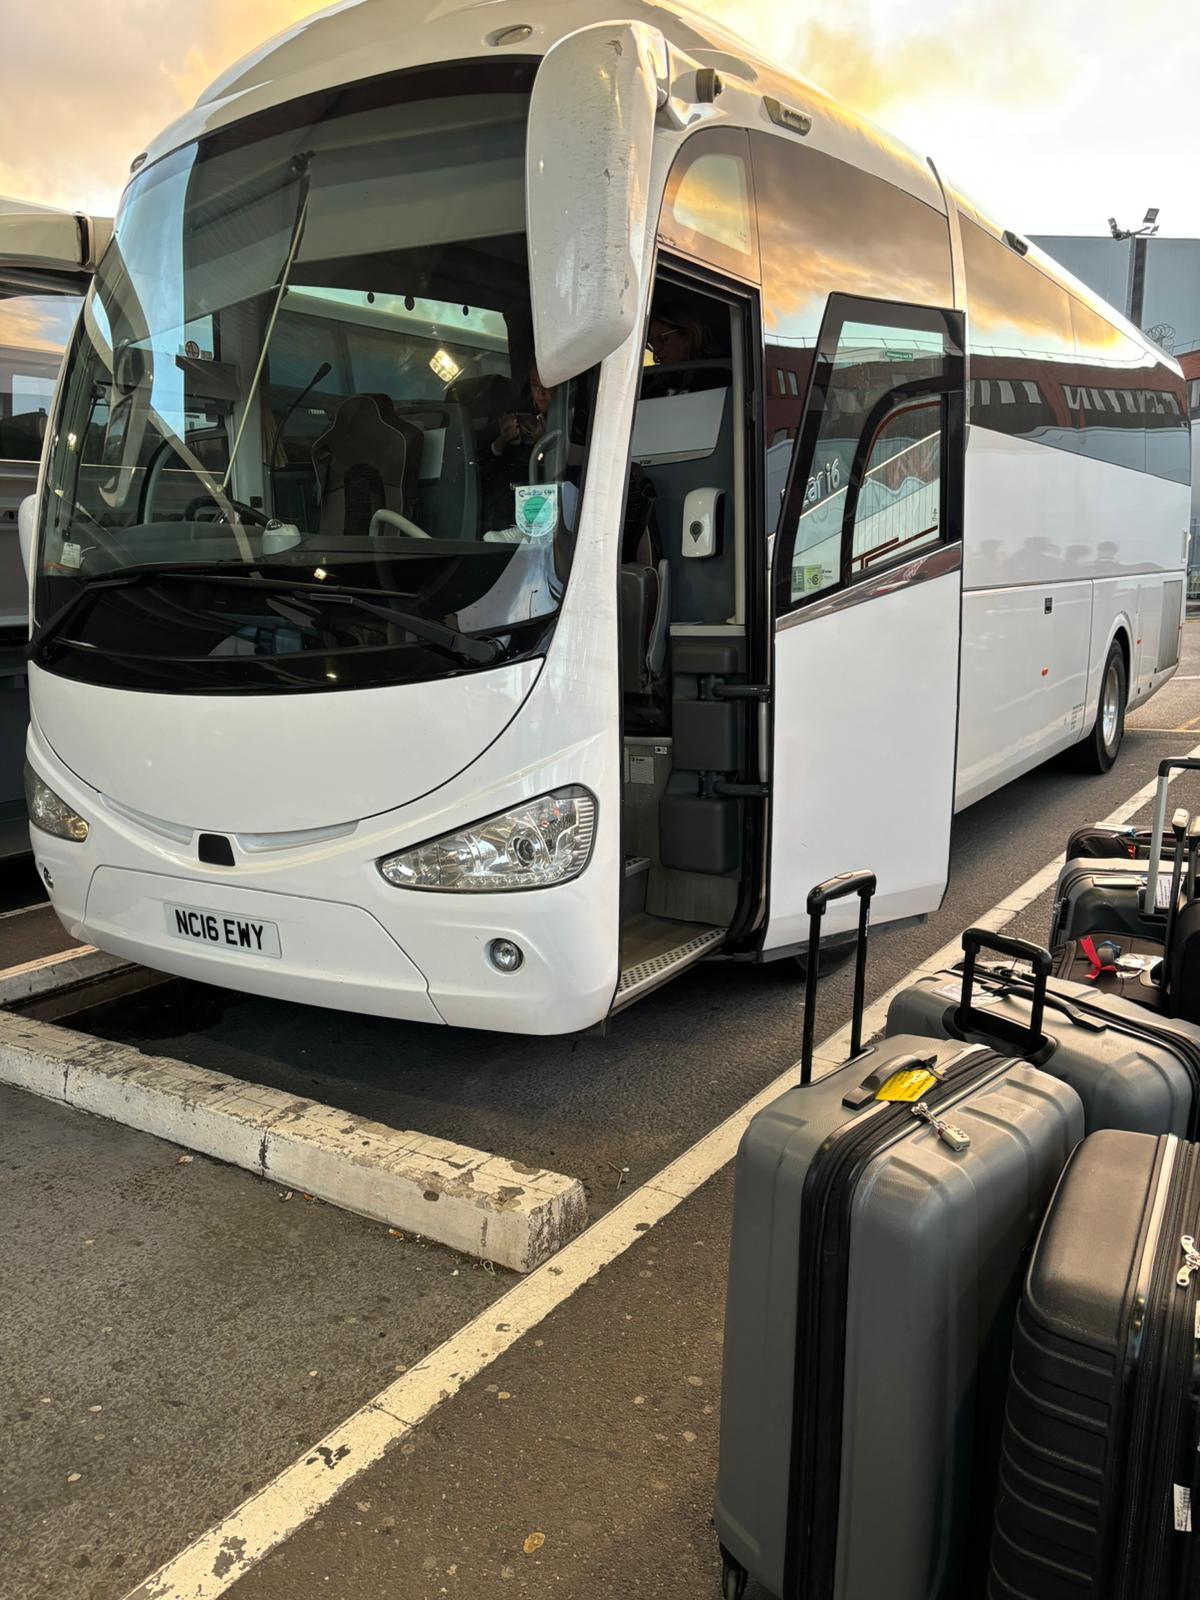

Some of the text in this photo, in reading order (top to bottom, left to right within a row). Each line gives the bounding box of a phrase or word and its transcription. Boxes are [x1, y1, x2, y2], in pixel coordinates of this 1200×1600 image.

[826, 458, 840, 493] i6
[175, 909, 264, 950] NC16 EWY
